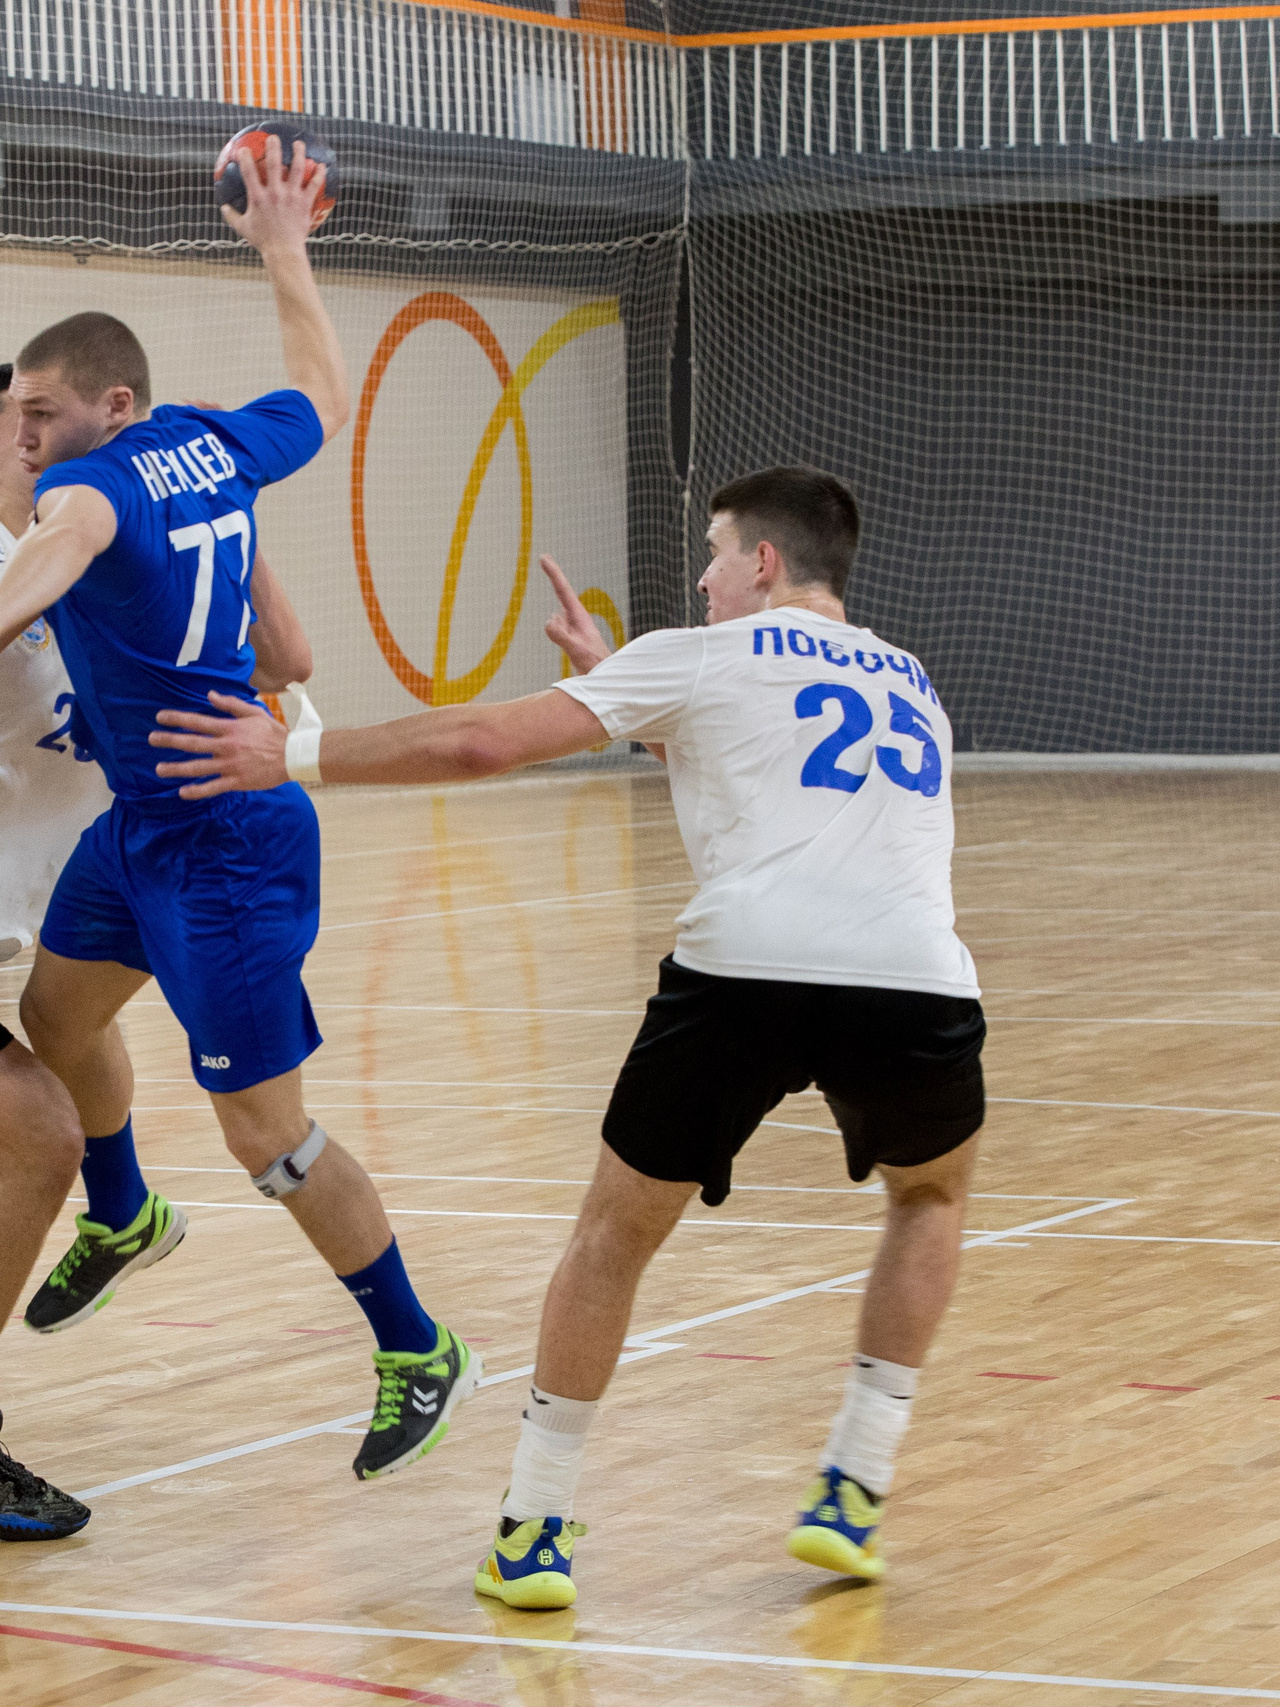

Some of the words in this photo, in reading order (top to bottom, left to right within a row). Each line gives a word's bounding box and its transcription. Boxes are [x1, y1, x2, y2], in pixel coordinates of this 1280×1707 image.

[130, 432, 237, 502] НЕЦЕВ
[168, 510, 251, 668] 77
[35, 692, 96, 763] 2
[794, 682, 943, 798] 25
[200, 1054, 231, 1070] JAKO
